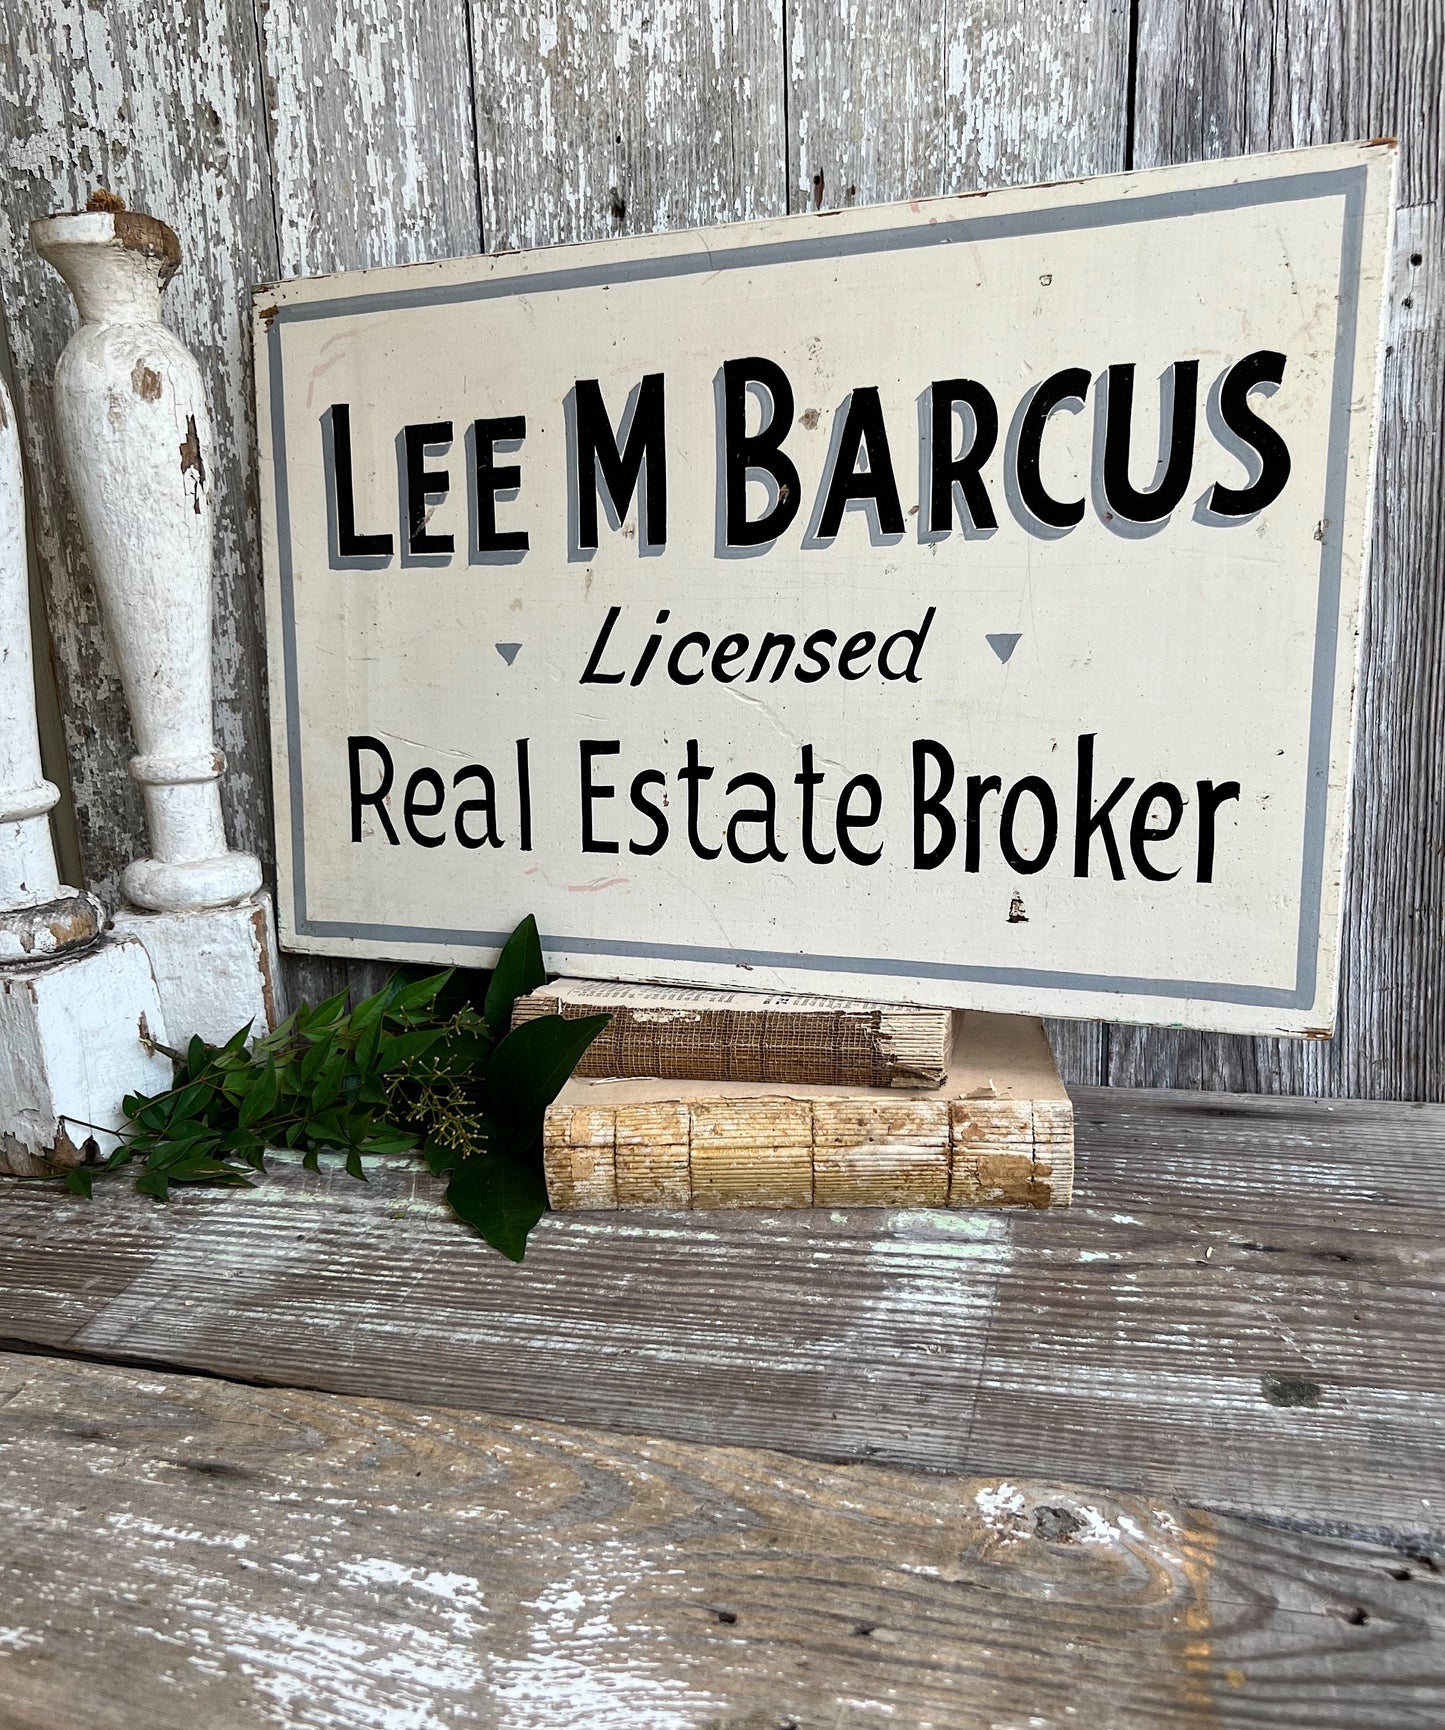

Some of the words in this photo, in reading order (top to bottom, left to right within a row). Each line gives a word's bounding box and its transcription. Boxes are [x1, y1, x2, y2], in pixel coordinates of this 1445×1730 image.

[319, 403, 530, 571] LEE
[562, 372, 668, 563] M
[712, 350, 1292, 559] BARCUS
[578, 606, 937, 686] Licensed
[347, 735, 533, 851] Real
[579, 738, 885, 865] Estate
[912, 733, 1241, 884] Broker
